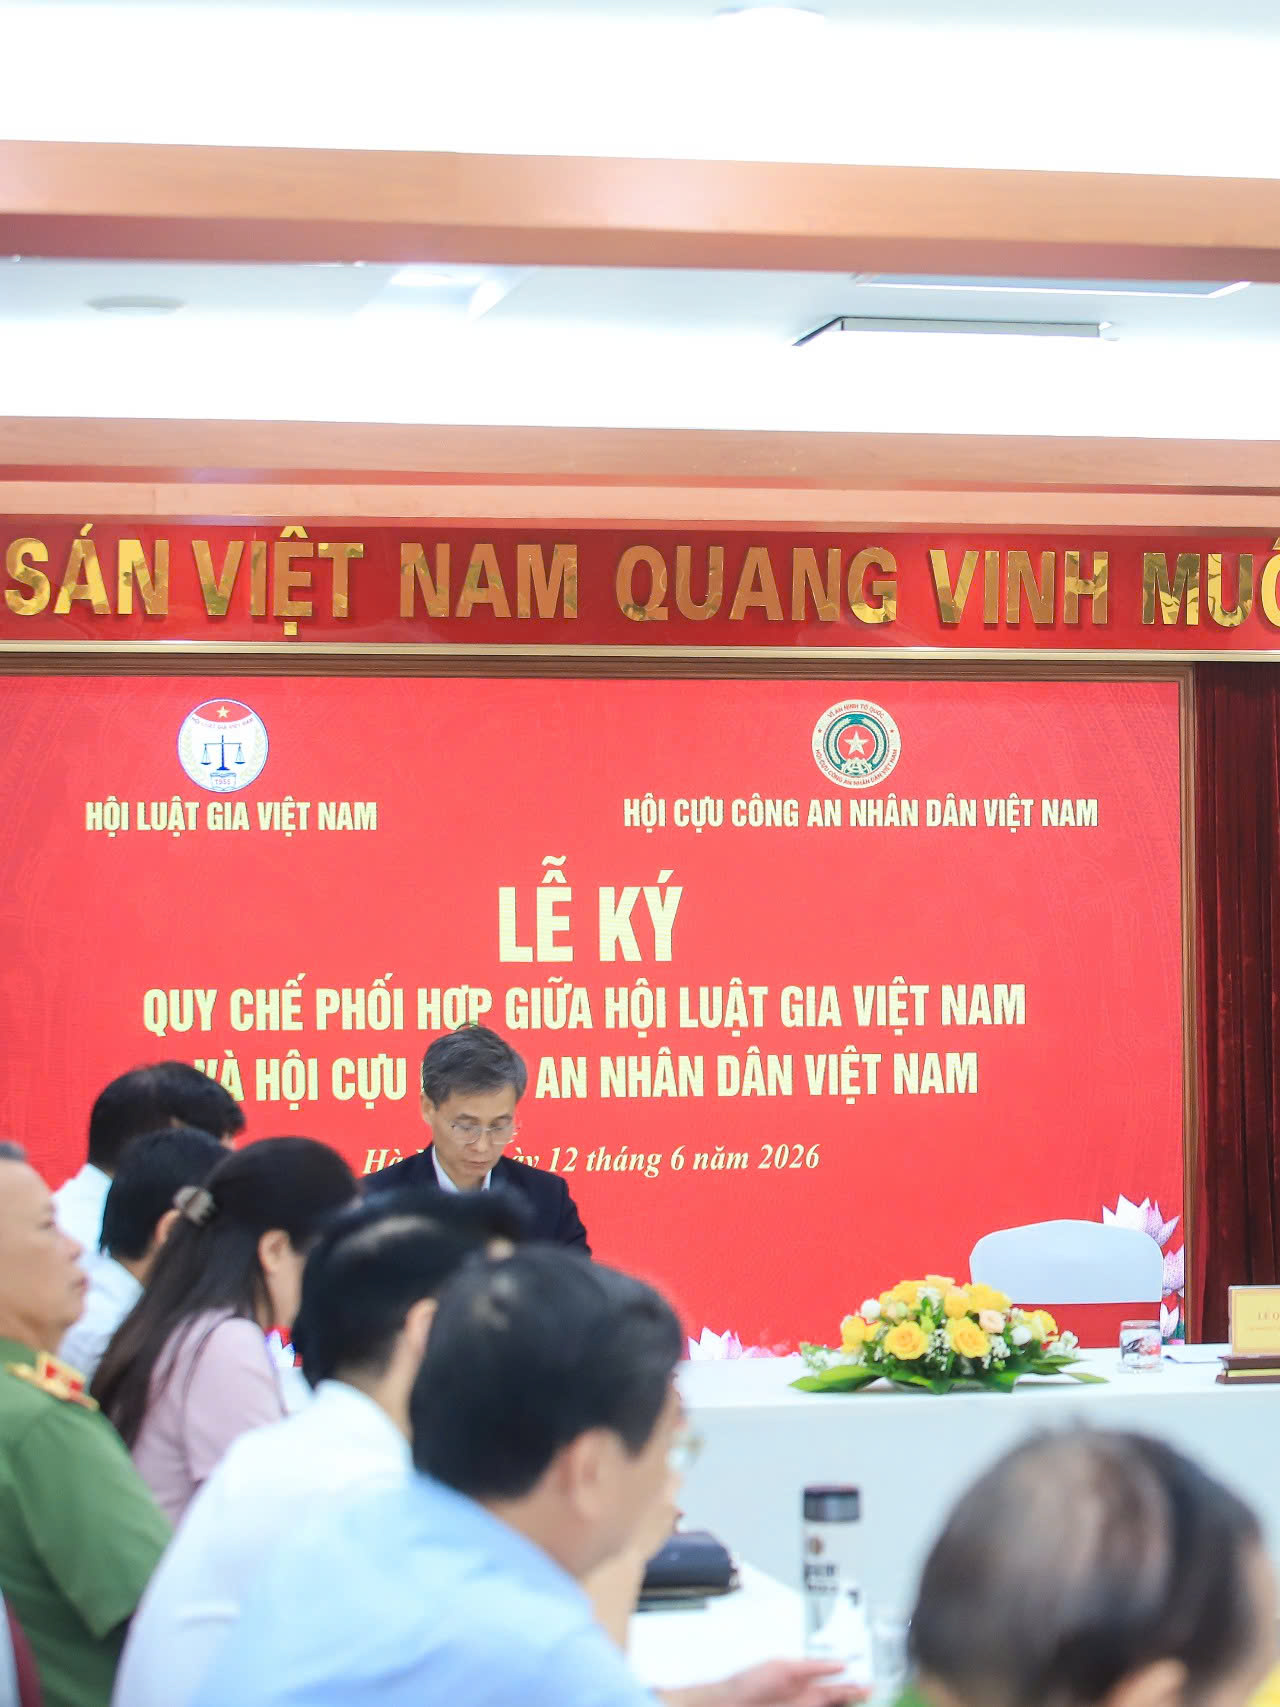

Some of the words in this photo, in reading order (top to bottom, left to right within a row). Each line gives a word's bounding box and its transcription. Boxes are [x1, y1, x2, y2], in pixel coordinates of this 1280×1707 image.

[4, 523, 170, 617] SÁN
[191, 526, 365, 636] VIỆT
[400, 543, 578, 620] NAM
[615, 545, 898, 624] QUANG
[929, 548, 1109, 626] VINH
[85, 795, 129, 838] HỘI
[136, 795, 200, 838] LUẬT
[206, 801, 250, 831] GIA
[256, 795, 311, 838] VIỆT
[317, 801, 378, 831] NAM
[623, 792, 666, 834] HỘI
[673, 795, 724, 834] CỰU
[731, 792, 799, 828] CÔNG
[806, 798, 842, 827] AN
[849, 792, 919, 827] NHÂN
[926, 792, 977, 827] DÂN
[983, 792, 1035, 833] VIỆT
[1041, 798, 1098, 827] NAM
[498, 855, 574, 963] LỄ
[598, 869, 684, 962] KÝ
[143, 988, 218, 1037] QUY
[229, 972, 306, 1032] CHẾ
[315, 972, 404, 1031] PHỐI
[417, 984, 493, 1031] HỢP
[505, 975, 594, 1030] GIỮA
[604, 977, 667, 1039] HỘI
[679, 976, 769, 1038] LUẬT
[780, 985, 843, 1028] GIA
[852, 975, 930, 1036] VIỆT
[941, 983, 1026, 1026] NAM
[255, 1048, 319, 1111] HỘI
[331, 1053, 407, 1110] CỰU
[534, 1056, 588, 1099] AN
[599, 1046, 704, 1098] NHÂN
[717, 1045, 793, 1097] DÂN
[803, 1044, 882, 1105] VIỆT
[893, 1052, 978, 1095] NAM
[548, 1146, 579, 1173] 12
[585, 1145, 663, 1178] tháng
[670, 1145, 685, 1171] 6
[692, 1145, 749, 1171] năm
[757, 1143, 820, 1169] 2026
